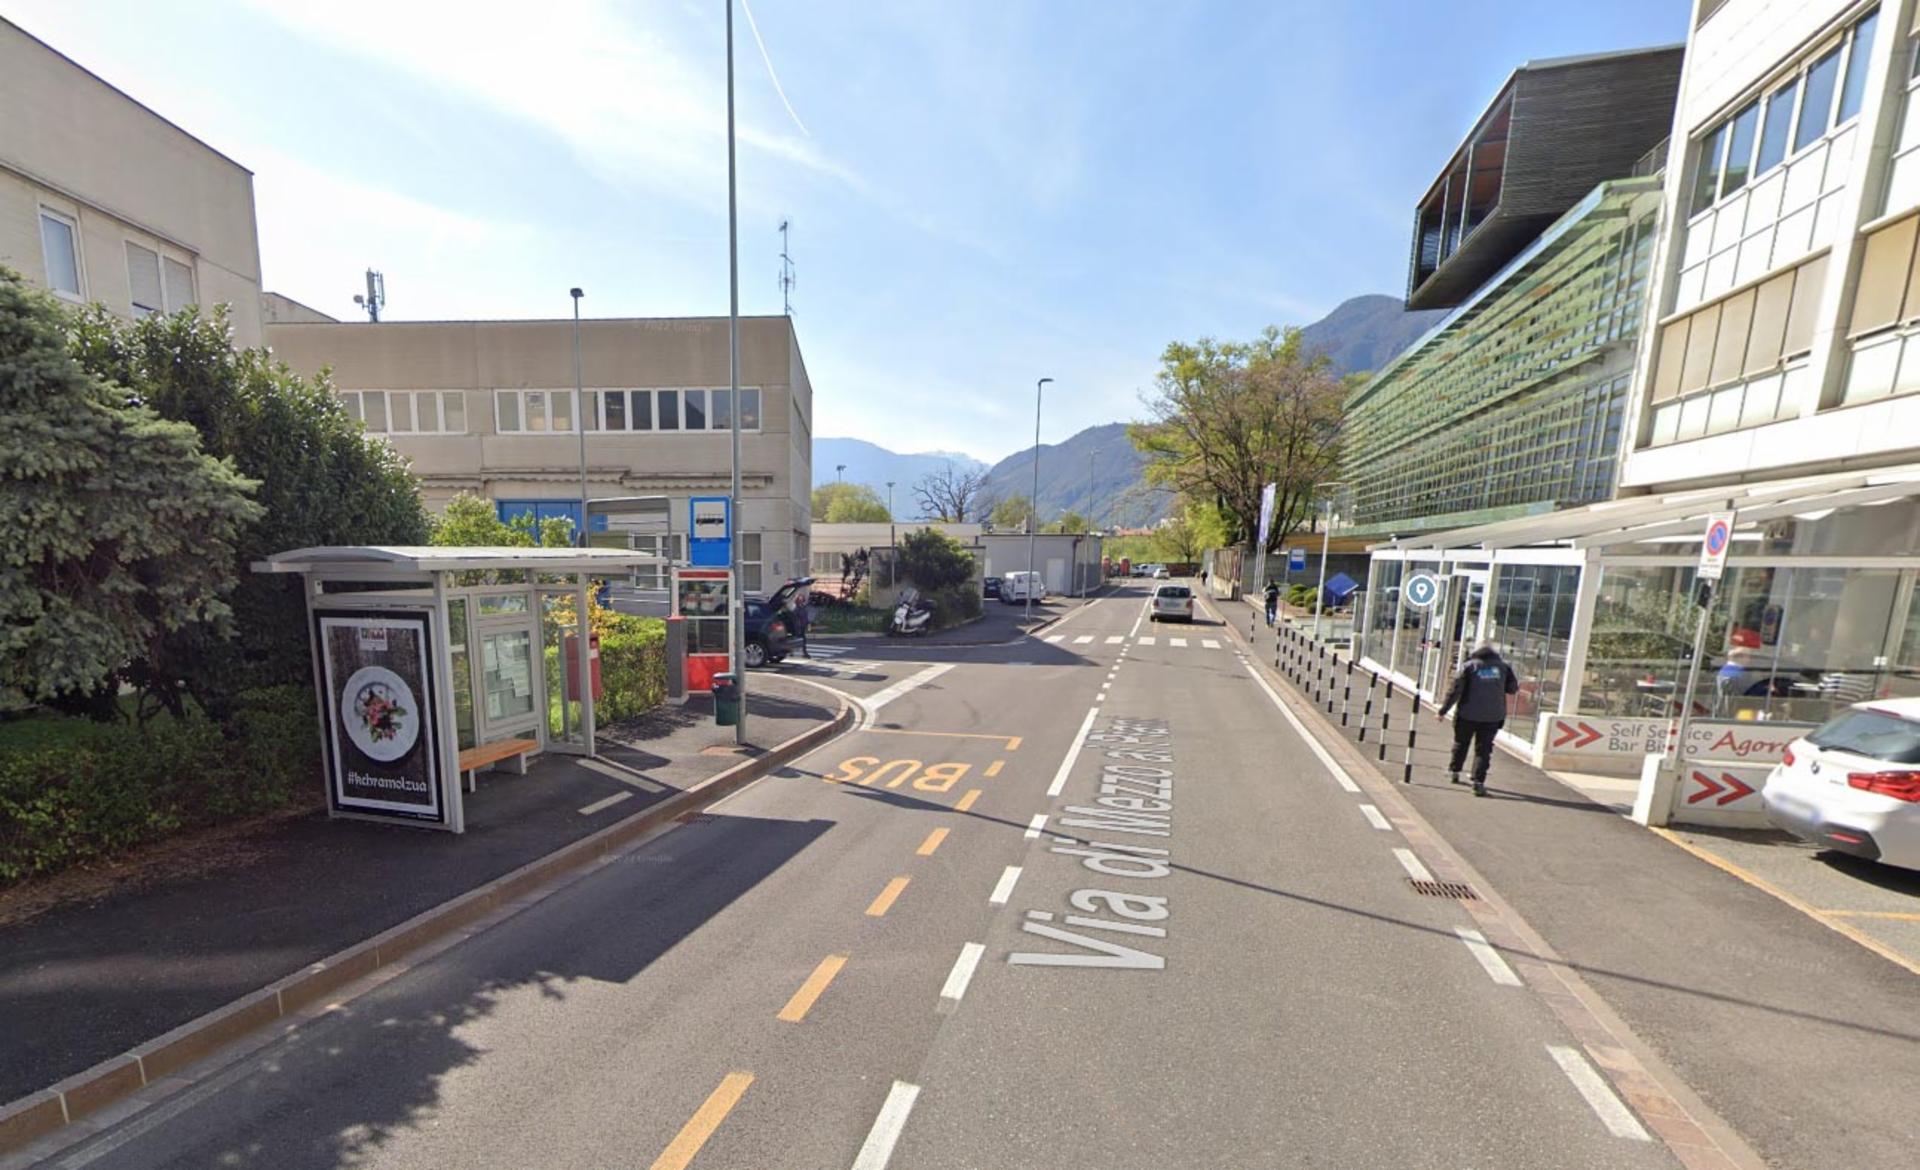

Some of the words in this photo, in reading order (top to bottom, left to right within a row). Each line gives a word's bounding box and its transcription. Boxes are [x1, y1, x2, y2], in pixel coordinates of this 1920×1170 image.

[1610, 723, 1641, 738] Self
[1646, 725, 1714, 742] Seice
[1607, 737, 1640, 752] Bar
[822, 756, 972, 792] BUS
